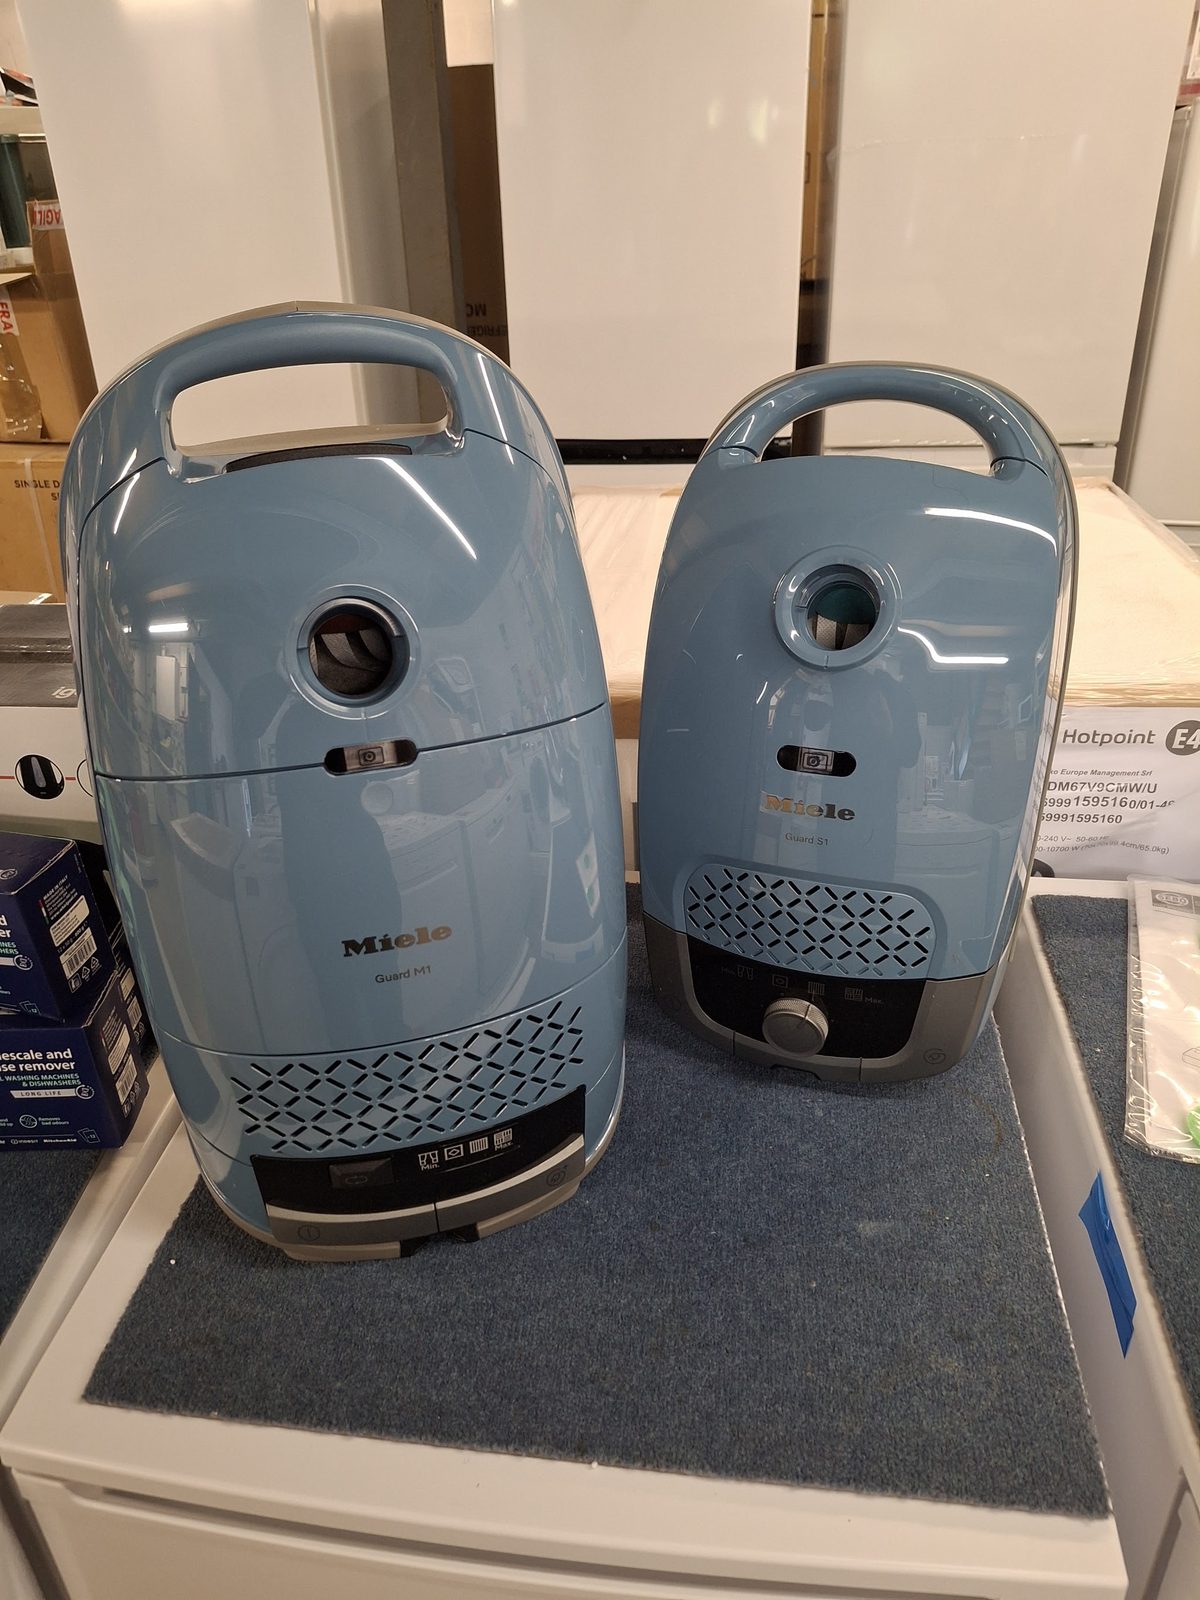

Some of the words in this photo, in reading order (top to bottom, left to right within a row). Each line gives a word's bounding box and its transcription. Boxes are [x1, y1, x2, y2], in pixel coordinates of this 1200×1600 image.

[14, 480, 50, 488] SINGLE
[52, 686, 77, 699] ig
[1062, 729, 1156, 746] Hotpoint
[1172, 729, 1200, 749] E4
[1090, 769, 1139, 777] Management
[766, 795, 855, 820] Miele
[785, 832, 814, 844] Guard
[817, 837, 828, 846] S1
[341, 926, 452, 957] Miele
[375, 970, 411, 983] Guard
[414, 966, 432, 976] M1
[46, 1048, 73, 1060] and
[19, 1061, 75, 1071] remover
